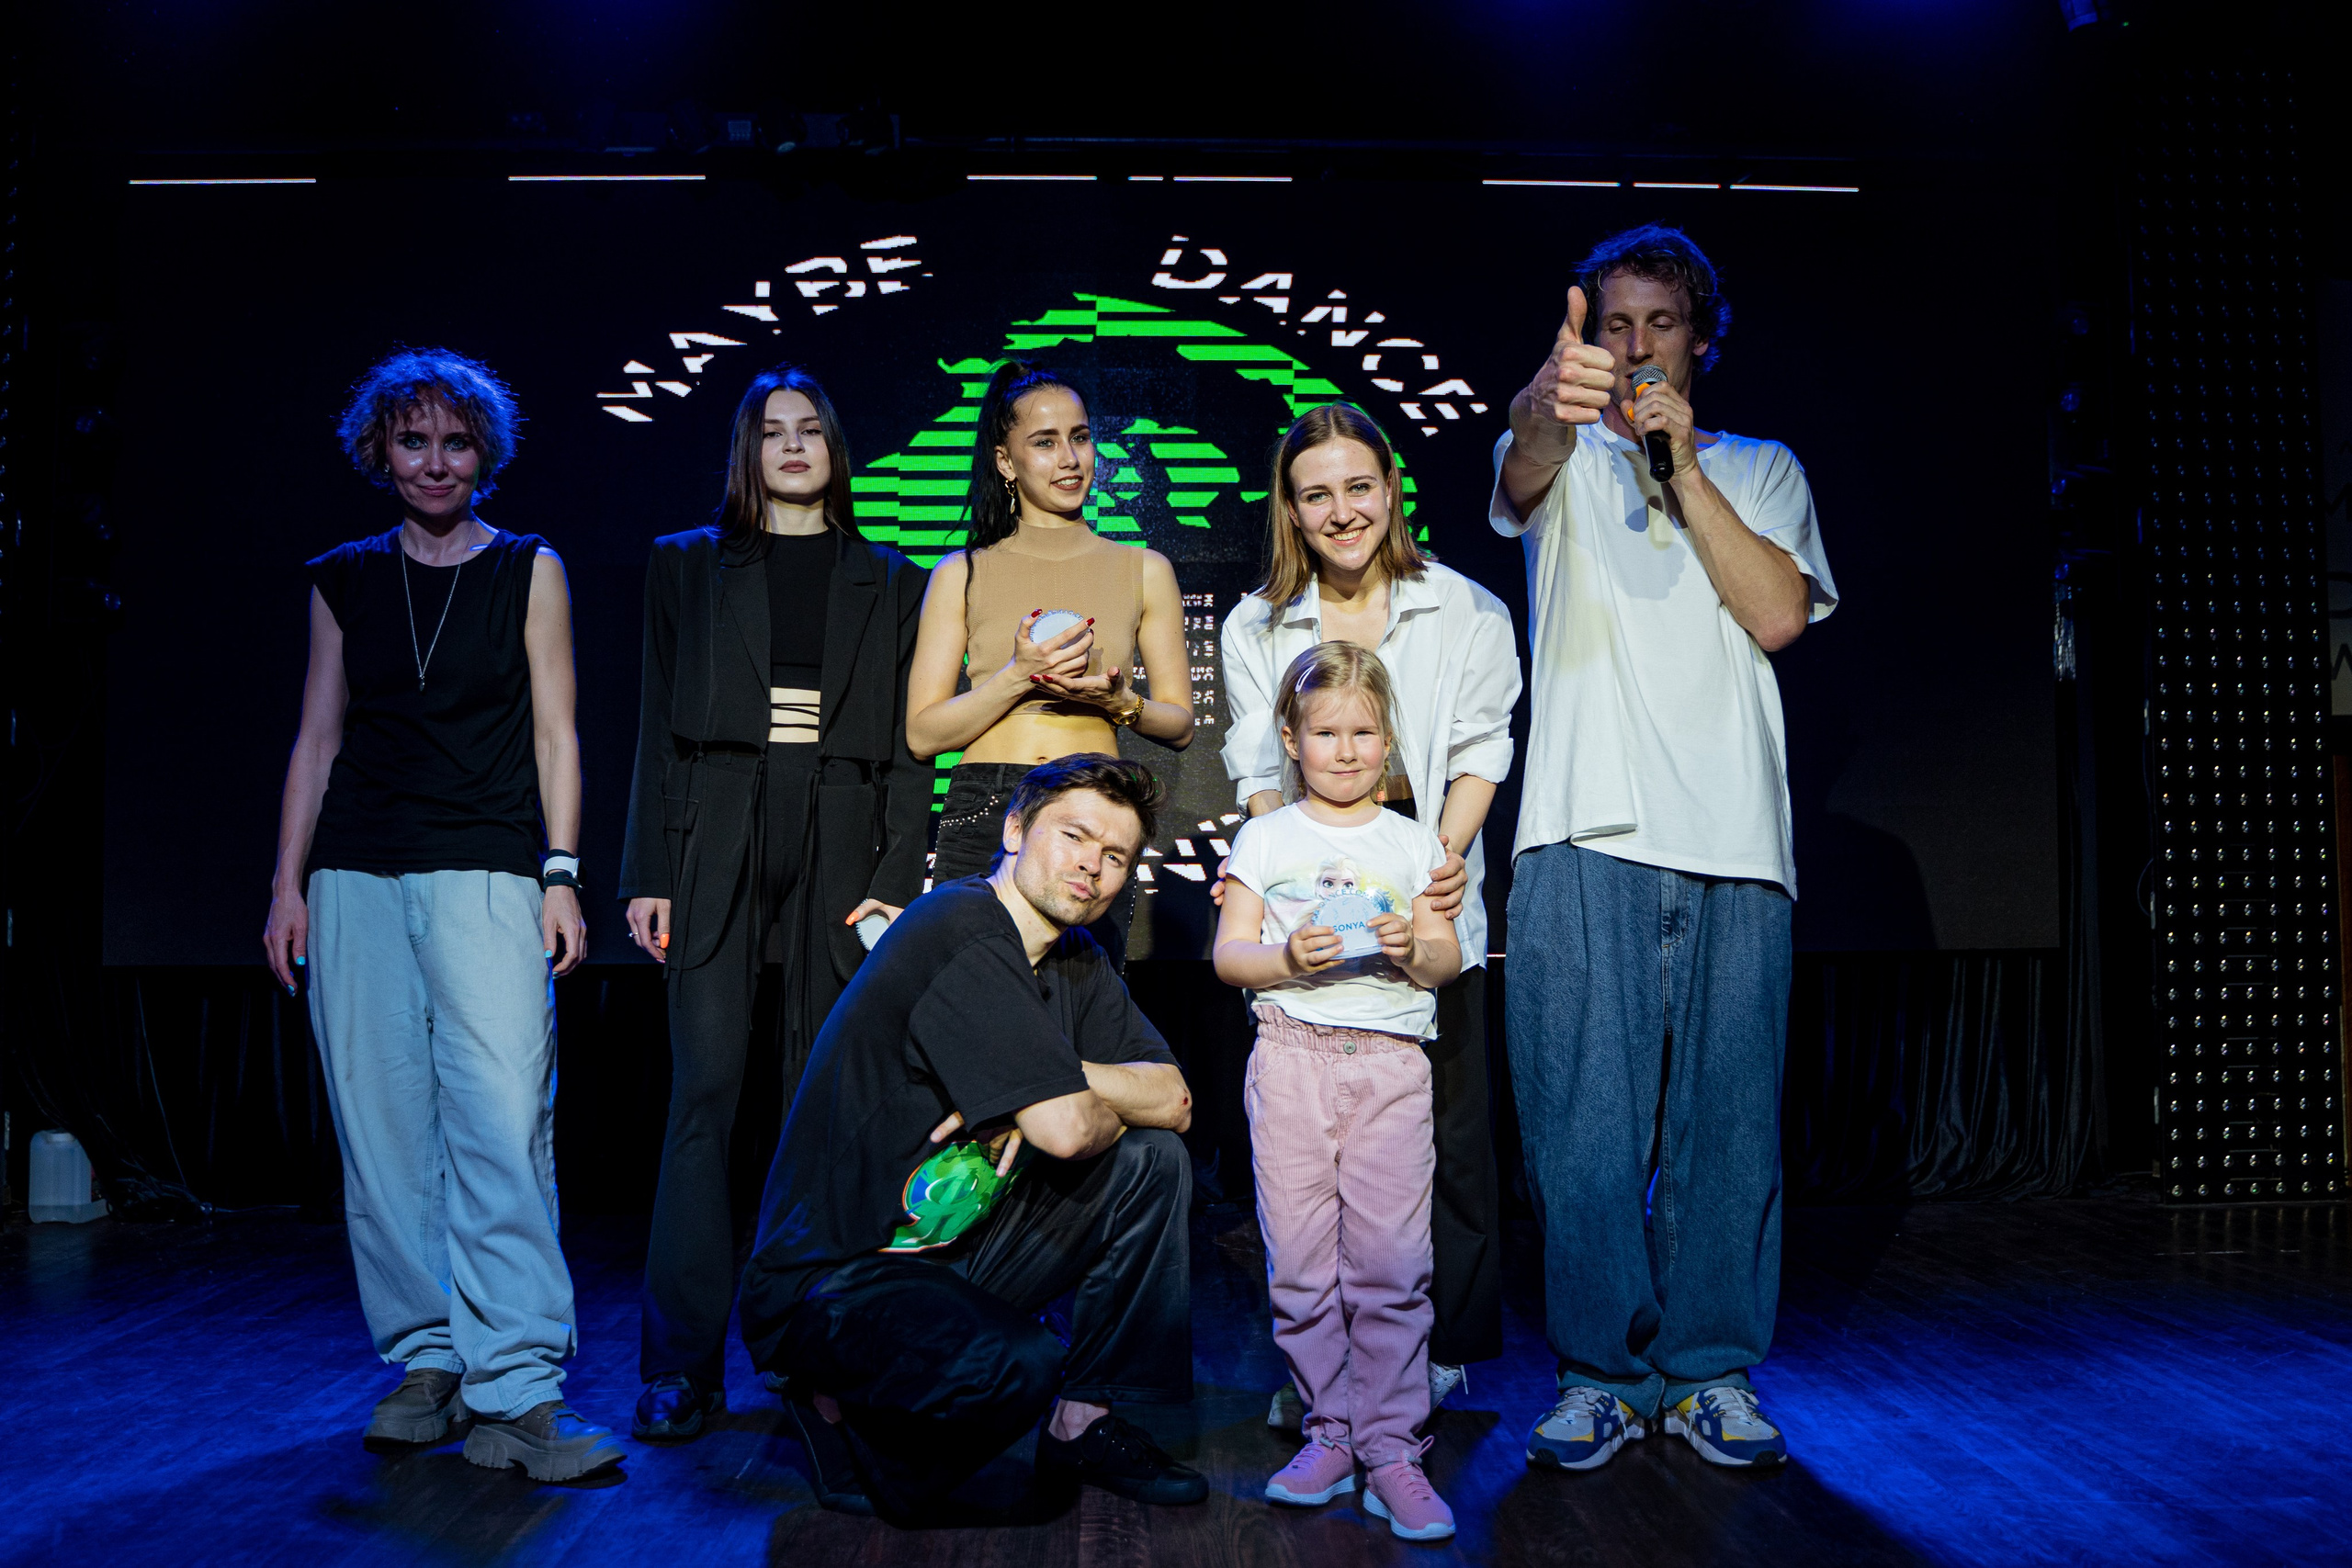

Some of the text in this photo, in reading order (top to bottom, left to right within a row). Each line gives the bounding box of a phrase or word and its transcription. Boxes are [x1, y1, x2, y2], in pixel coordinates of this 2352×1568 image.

[596, 234, 1488, 437] MAYBE DANCE
[1333, 920, 1365, 933] SONYA
